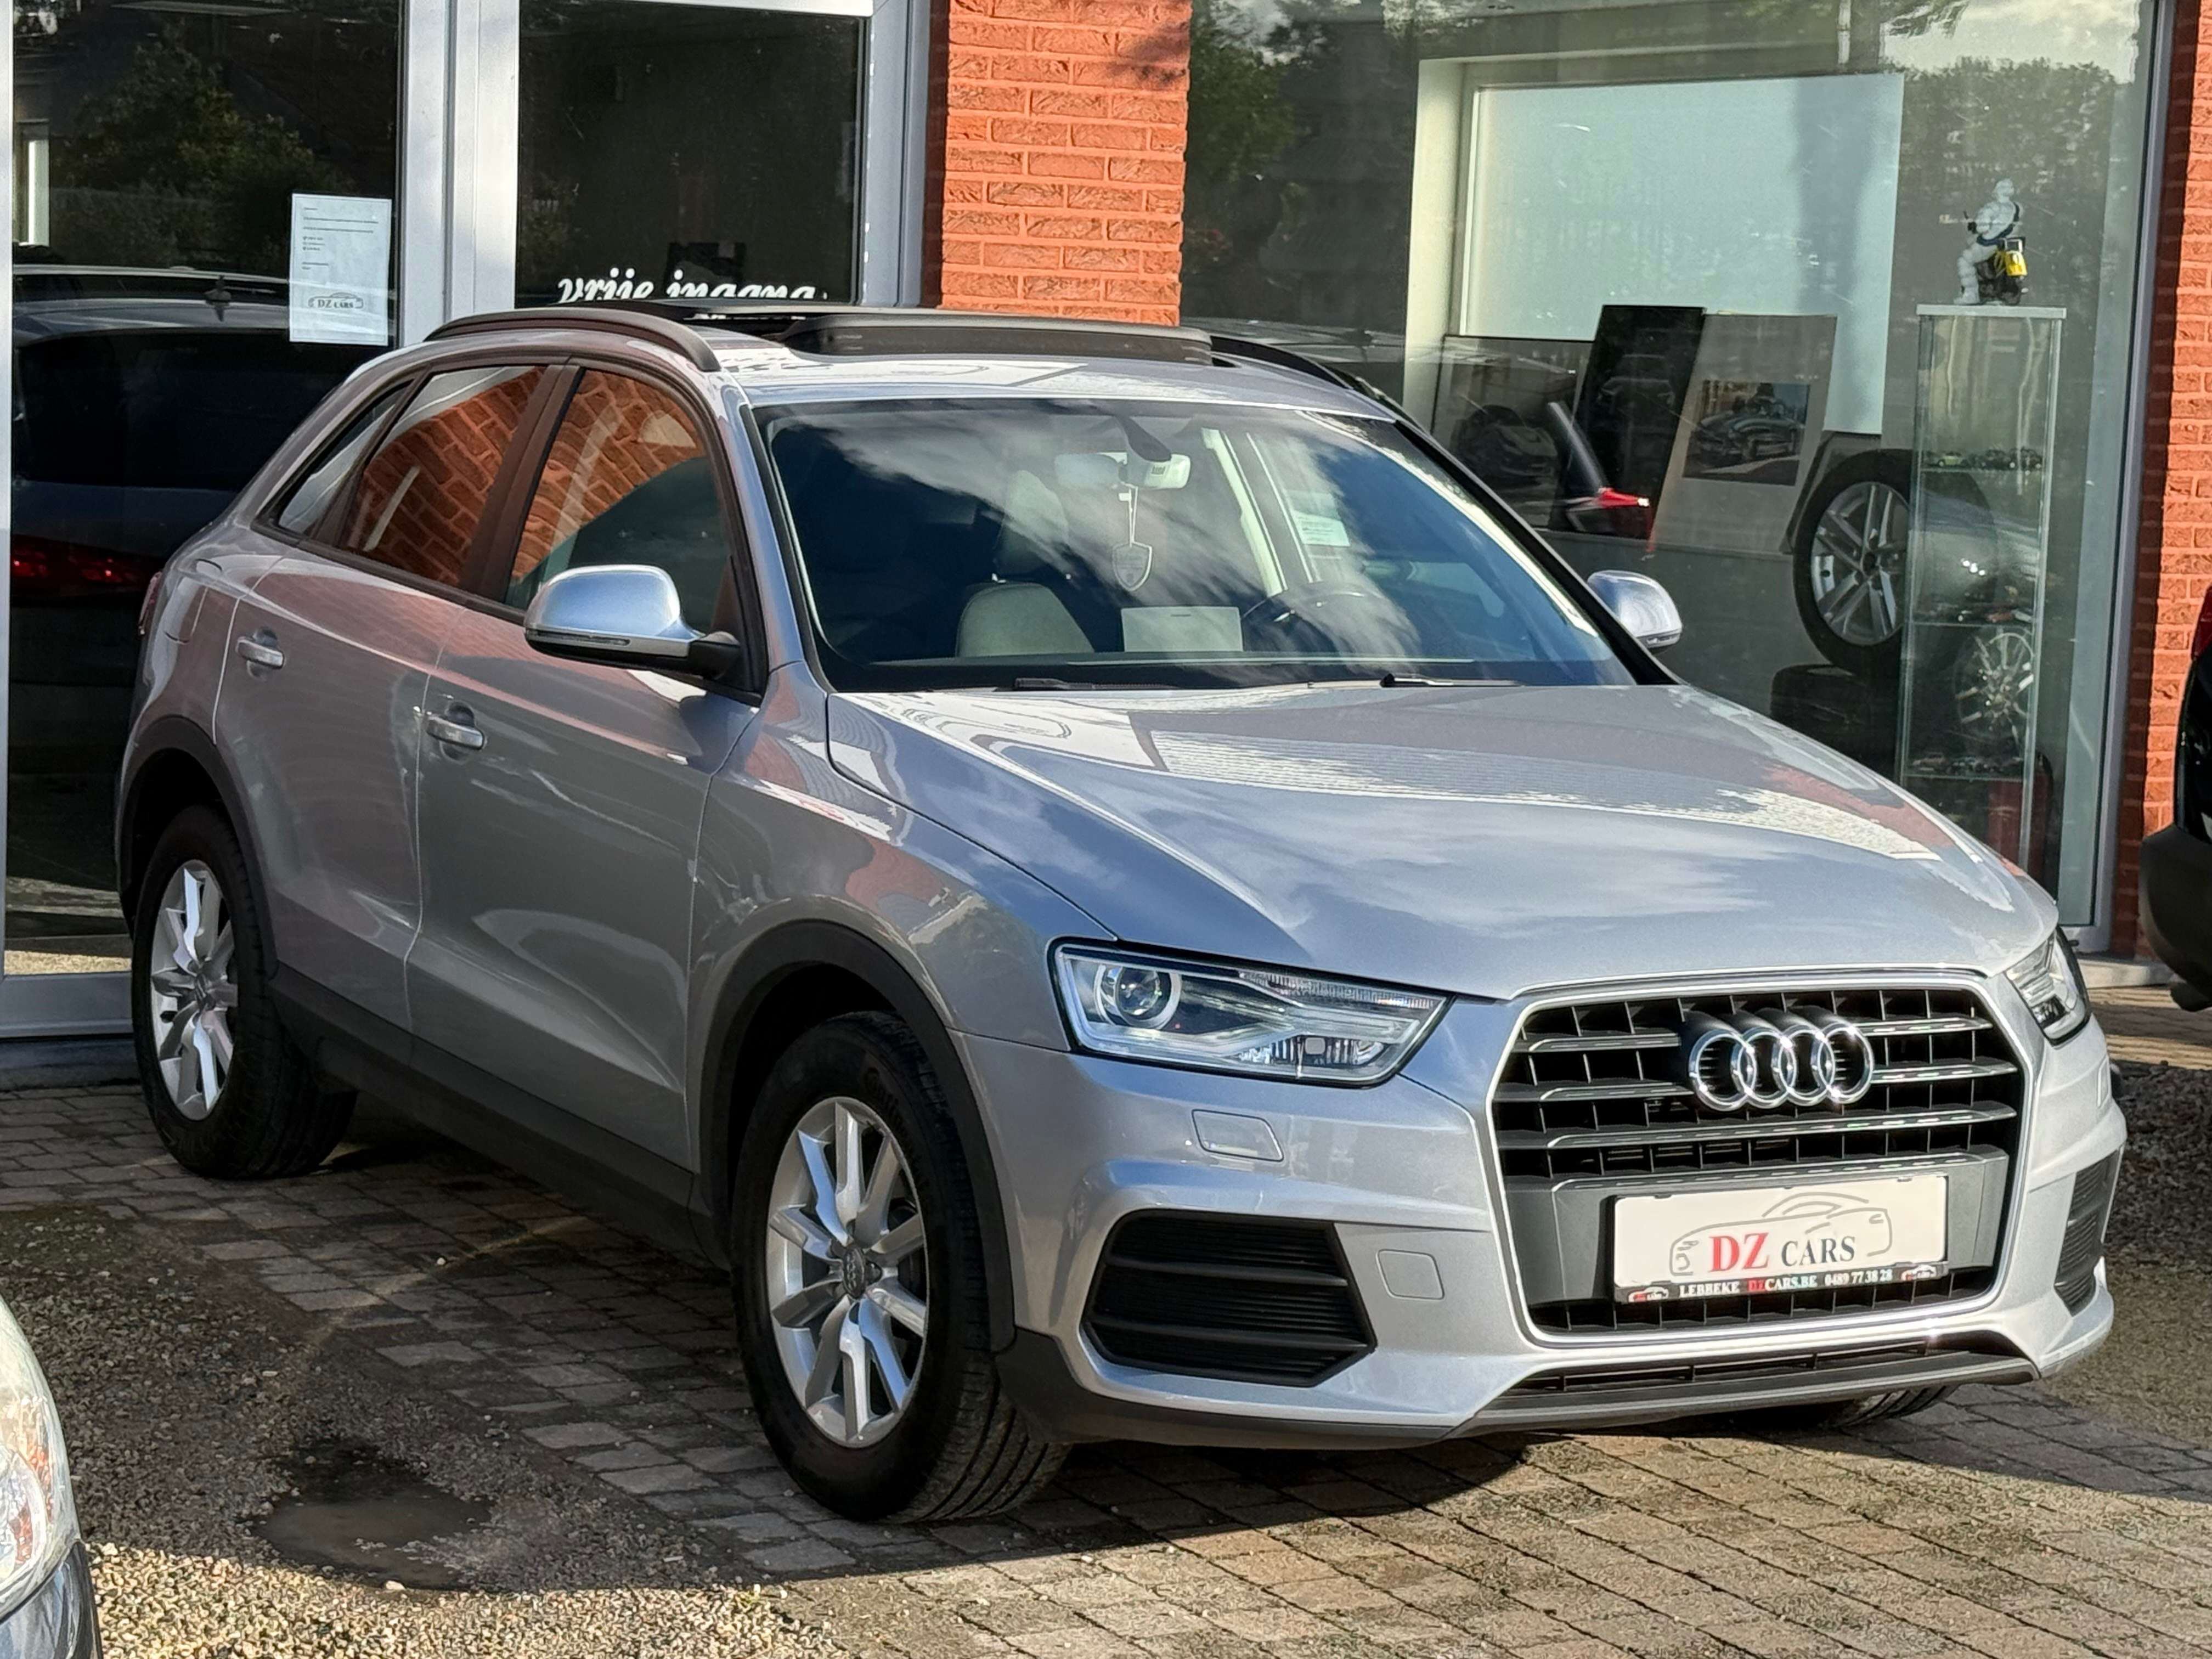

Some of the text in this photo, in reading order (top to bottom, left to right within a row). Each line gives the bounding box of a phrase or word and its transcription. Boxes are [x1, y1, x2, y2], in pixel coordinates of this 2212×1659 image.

[558, 268, 654, 303] vrije
[318, 299, 332, 308] DZ
[1708, 1232, 1855, 1272] DZ CARS
[1679, 1281, 1740, 1298] LEBBEKE
[1851, 1271, 1864, 1284] 77
[1865, 1269, 1878, 1284] 38
